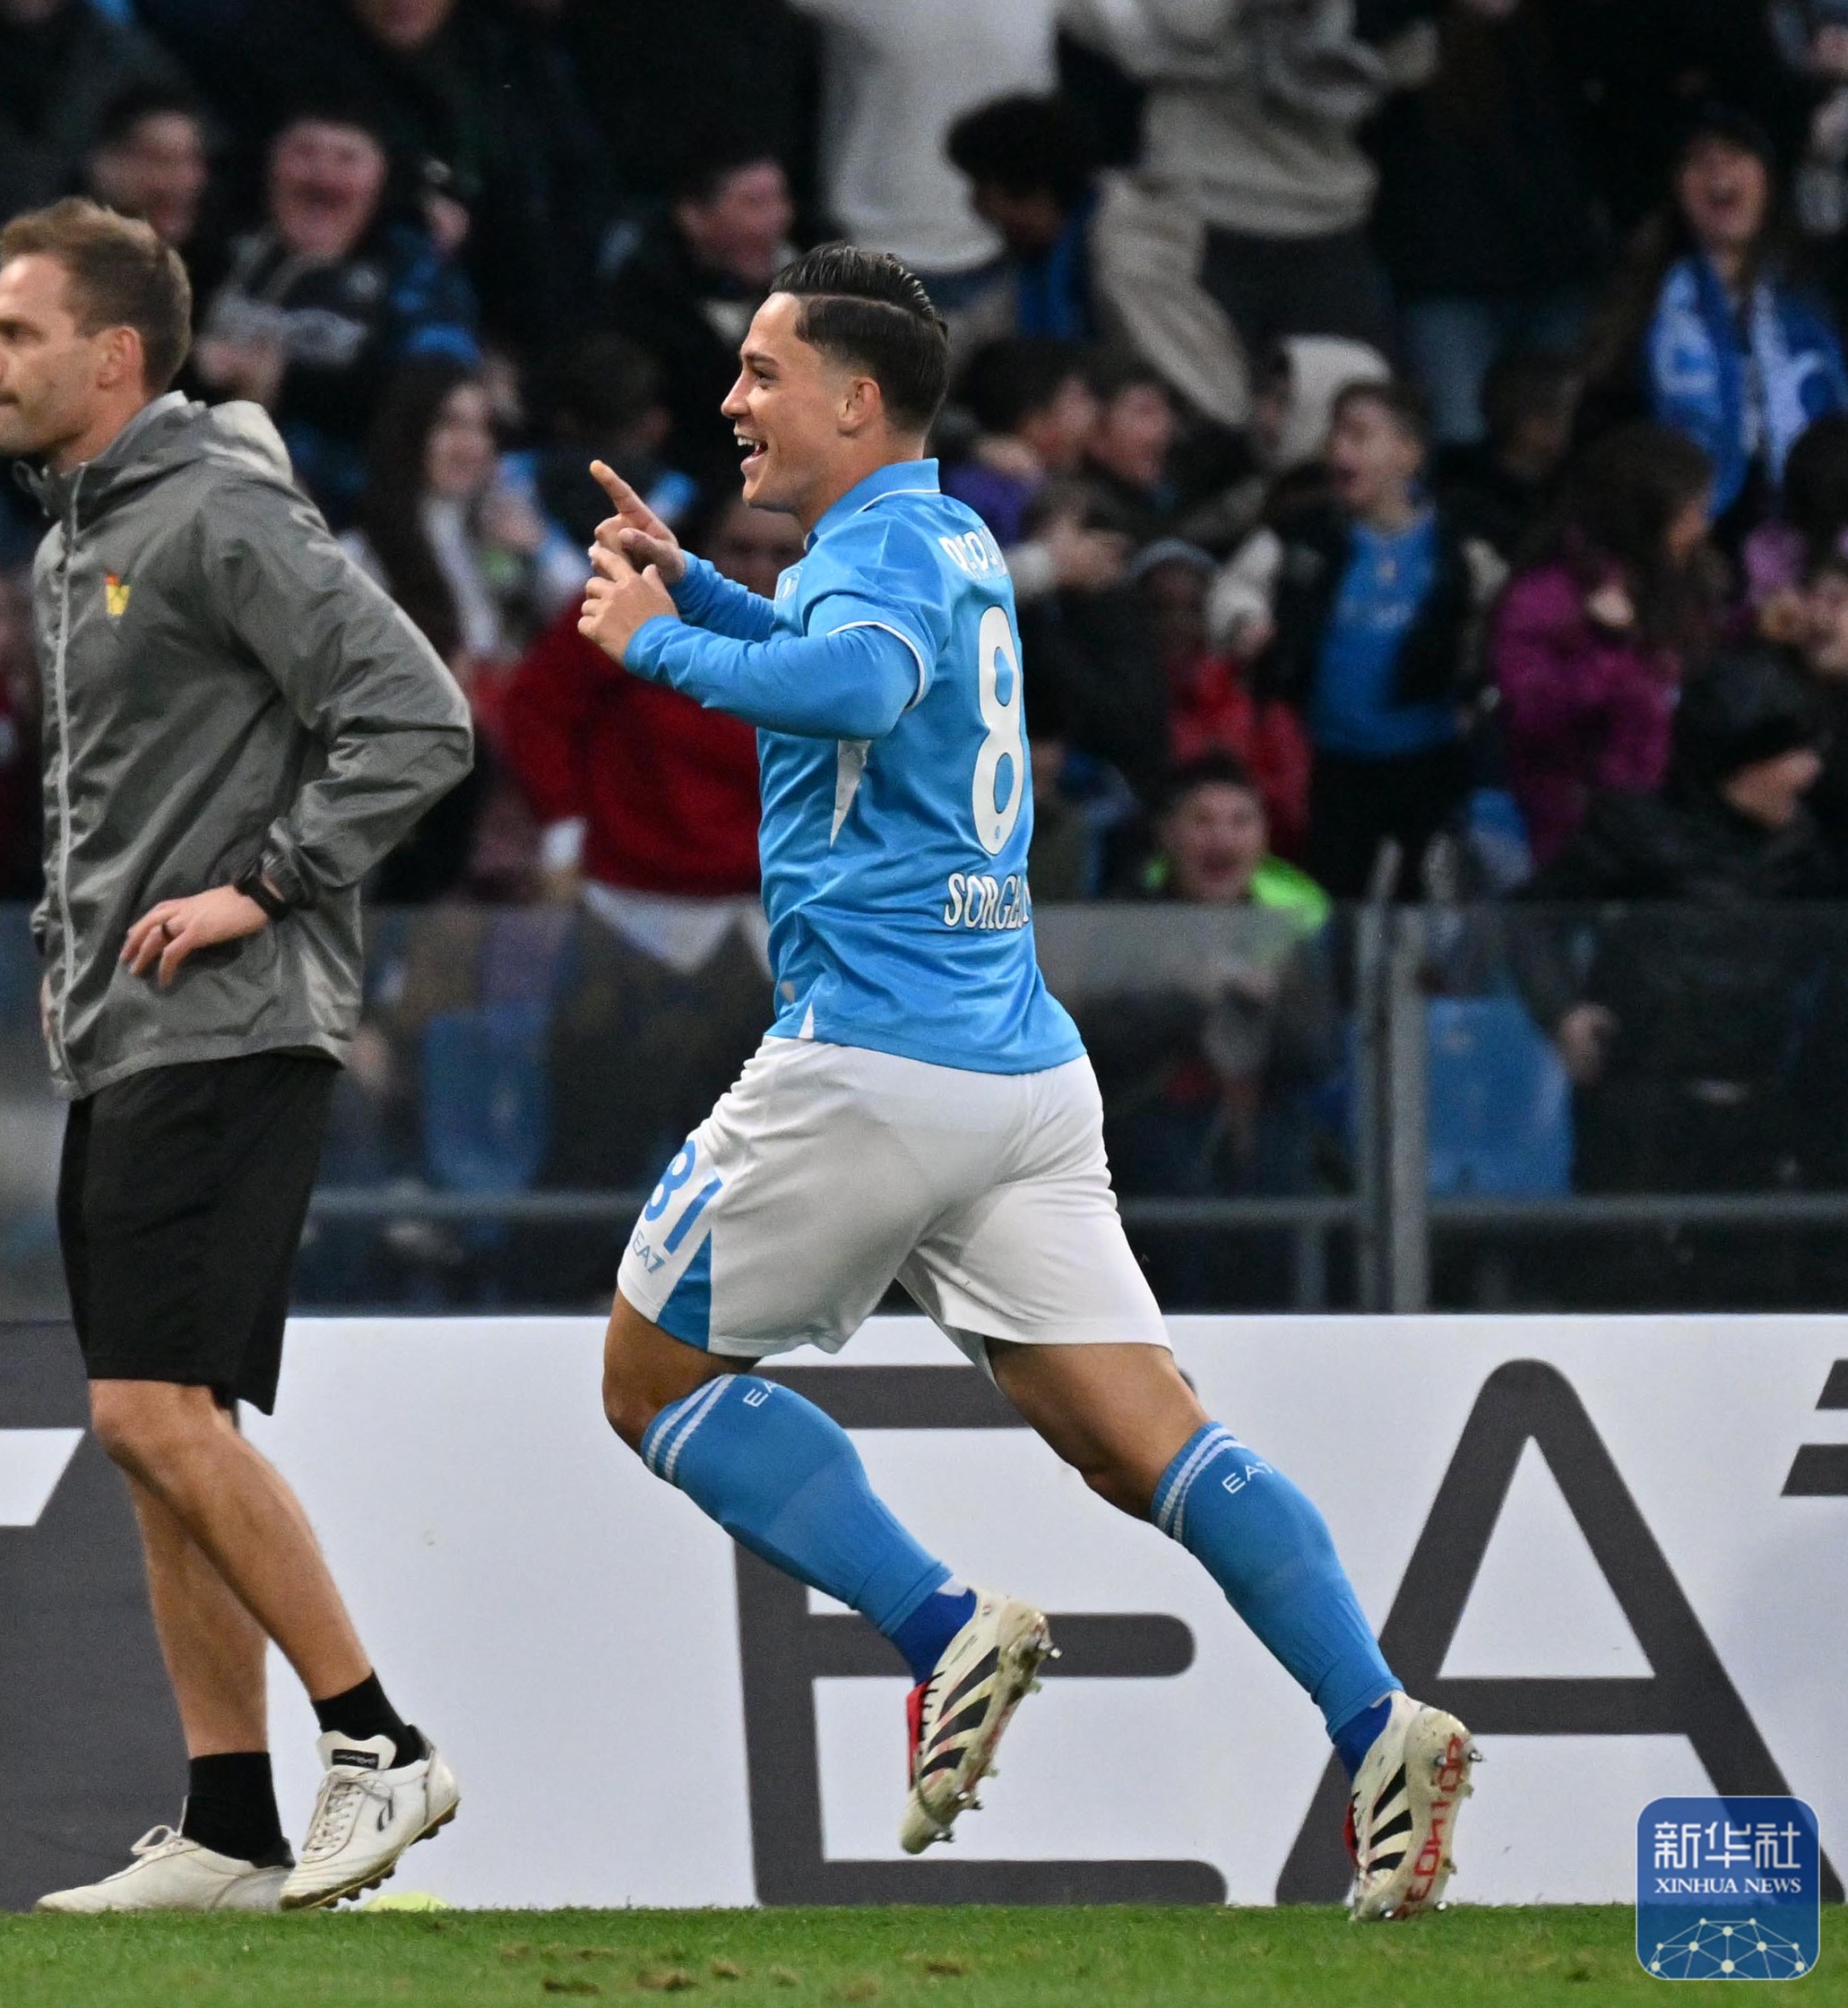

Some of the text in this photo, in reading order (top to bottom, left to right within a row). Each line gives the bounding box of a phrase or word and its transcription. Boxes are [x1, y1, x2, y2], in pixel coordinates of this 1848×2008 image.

[631, 1228, 667, 1274] EA7
[644, 1139, 723, 1255] 81
[733, 1358, 1848, 1905] EA
